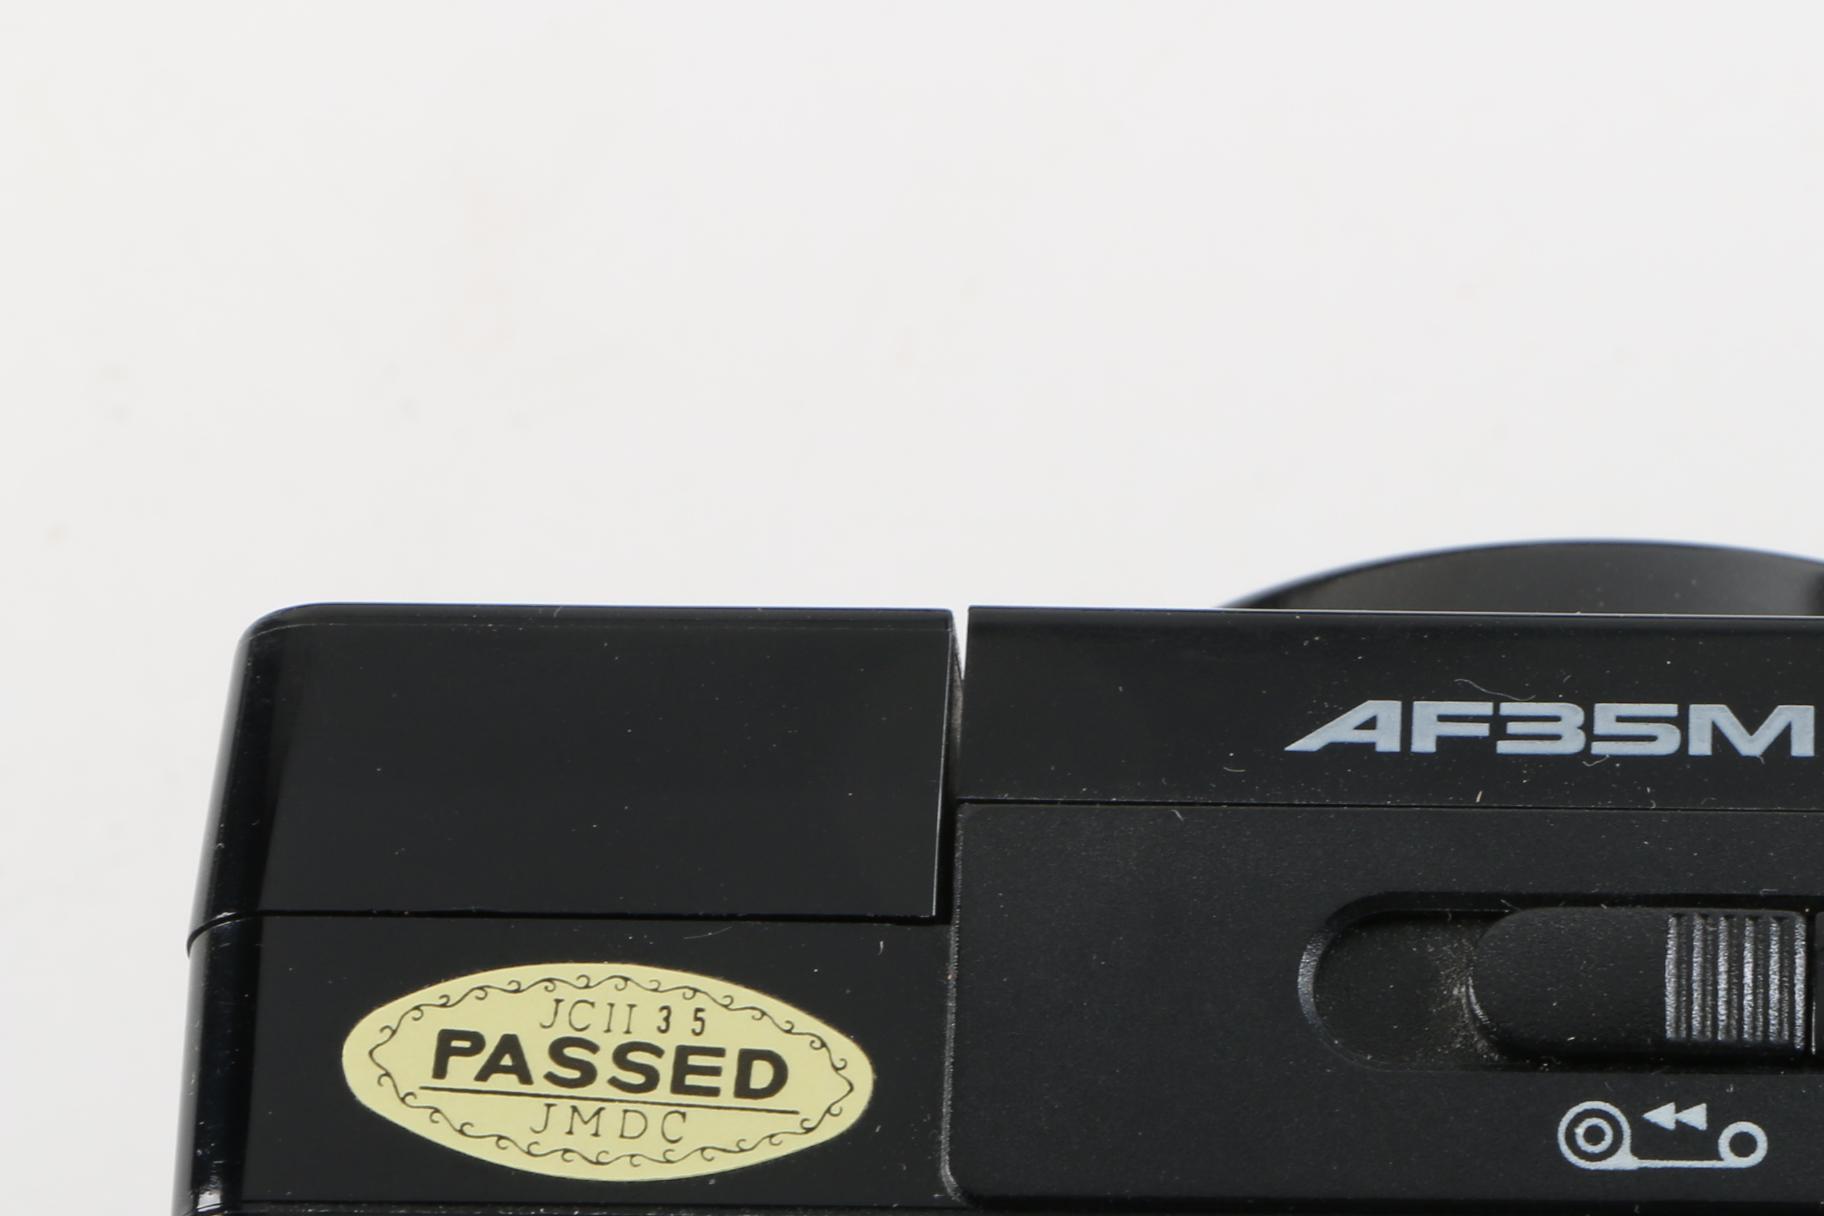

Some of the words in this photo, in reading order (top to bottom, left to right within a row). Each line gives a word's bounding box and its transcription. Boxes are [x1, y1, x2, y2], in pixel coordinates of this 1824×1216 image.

[1284, 699, 1815, 757] AF35M
[539, 997, 637, 1035] JCII
[431, 1027, 789, 1101] PASSED
[529, 1102, 688, 1144] JMDC
